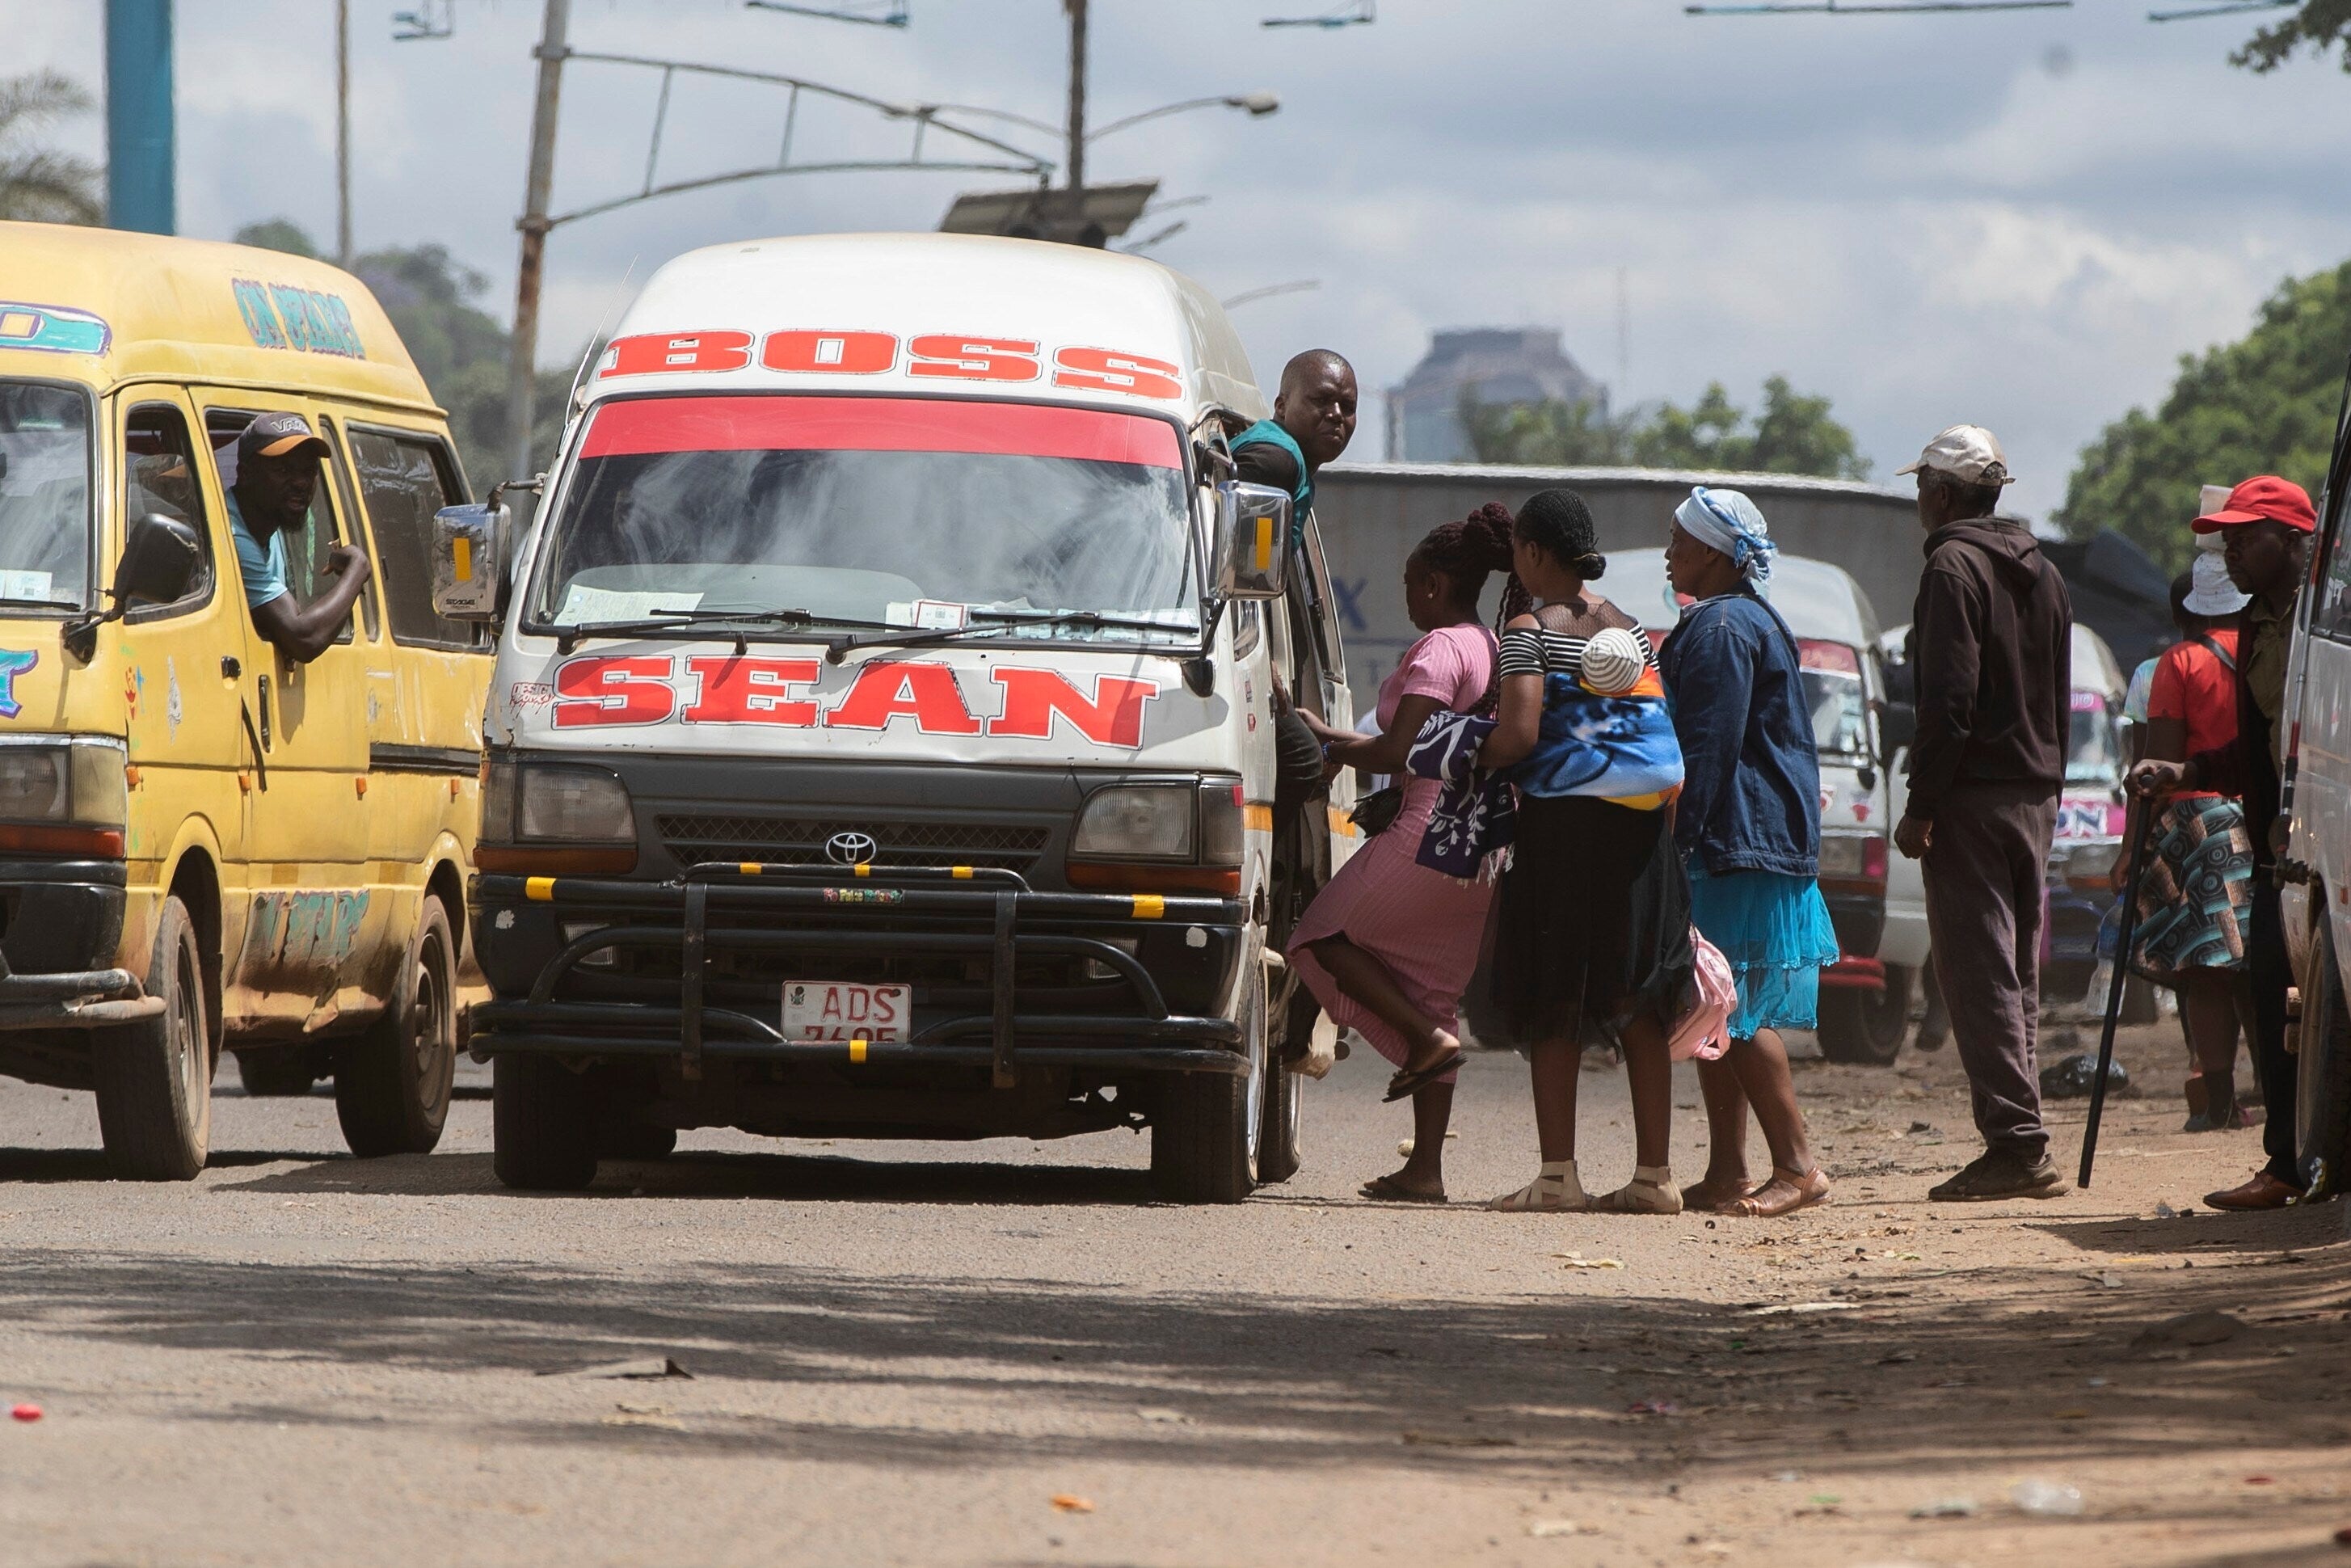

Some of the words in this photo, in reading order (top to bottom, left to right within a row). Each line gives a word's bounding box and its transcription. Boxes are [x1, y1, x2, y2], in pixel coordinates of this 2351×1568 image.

[597, 328, 1183, 400] BOSS
[553, 655, 1161, 750] SEAN
[820, 987, 897, 1023] ADS
